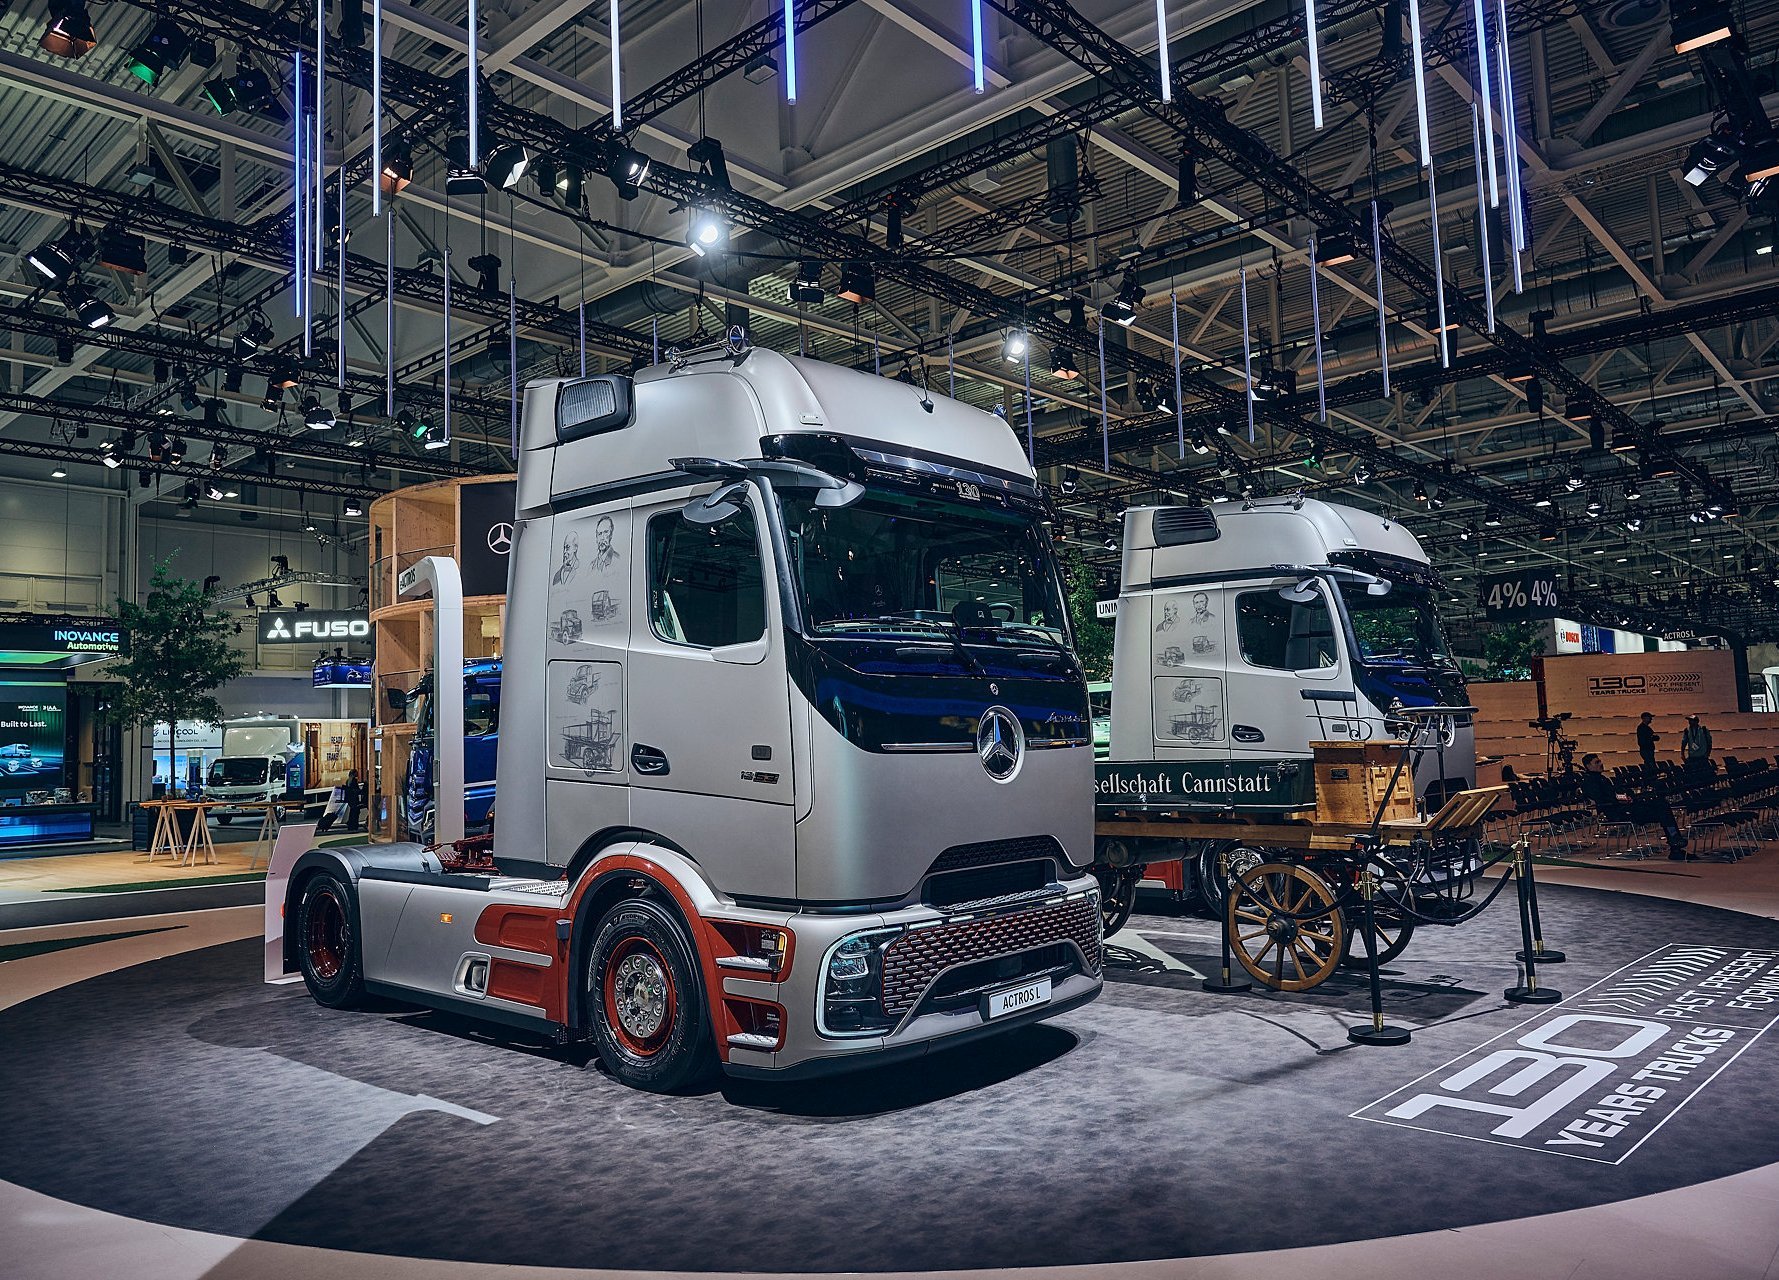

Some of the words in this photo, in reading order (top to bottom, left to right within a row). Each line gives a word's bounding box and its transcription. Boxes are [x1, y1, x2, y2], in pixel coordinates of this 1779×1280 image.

[1488, 581, 1527, 609] 4%
[1531, 580, 1557, 607] 4%
[54, 630, 119, 642] INOVANCE
[295, 620, 369, 638] FUSO
[1664, 631, 1689, 640] ACTROS
[1690, 630, 1696, 638] L
[67, 641, 119, 651] Automotive
[1589, 676, 1646, 690] 130
[162, 728, 198, 736] LICOOL
[1182, 772, 1271, 793] Cannstatt
[1002, 988, 1034, 1010] ACTROS
[1036, 986, 1041, 999] L
[1655, 990, 1726, 1018] PAST.
[1384, 1014, 1671, 1138] 130
[1544, 1083, 1666, 1148] YEARS
[1631, 1027, 1736, 1081] TRUCKS
